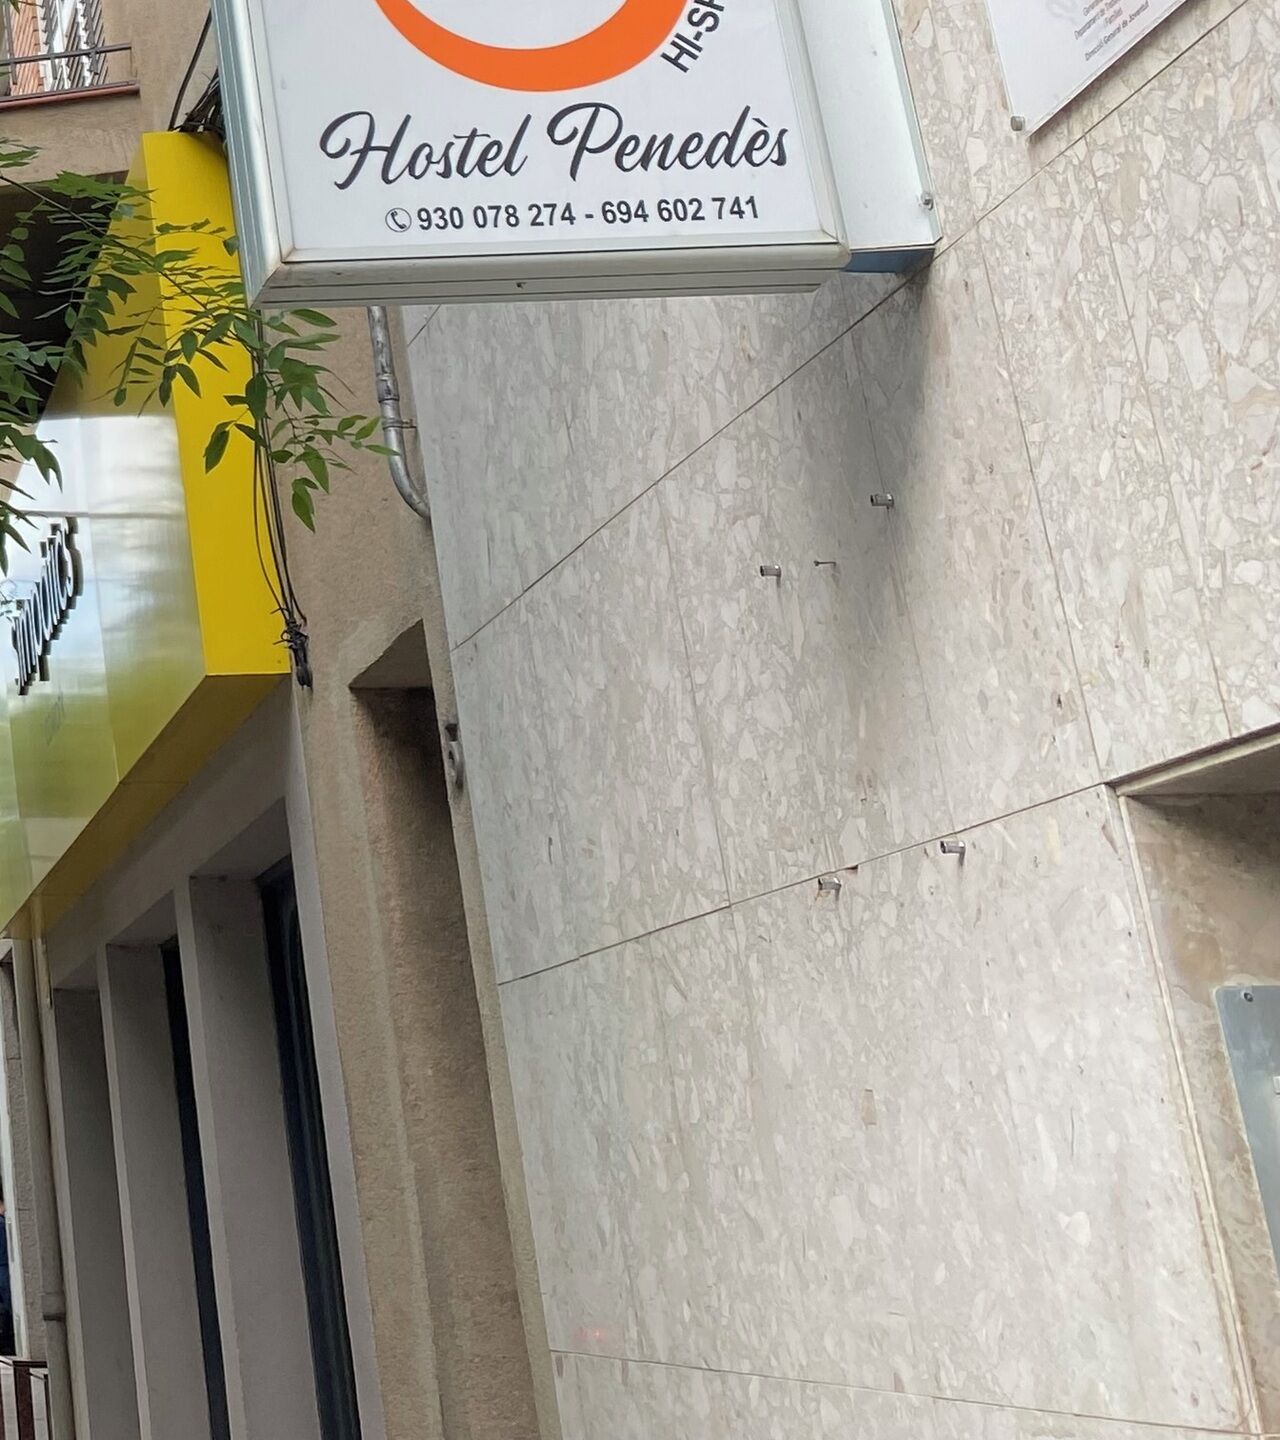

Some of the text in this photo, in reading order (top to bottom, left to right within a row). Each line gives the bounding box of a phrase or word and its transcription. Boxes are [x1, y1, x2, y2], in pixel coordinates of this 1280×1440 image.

[319, 101, 789, 190] Hostel Penedès
[416, 206, 464, 231] 930
[472, 204, 520, 229] 078
[527, 202, 576, 227] 274
[601, 199, 649, 224] 694
[656, 197, 706, 222] 602
[711, 195, 759, 220] 741
